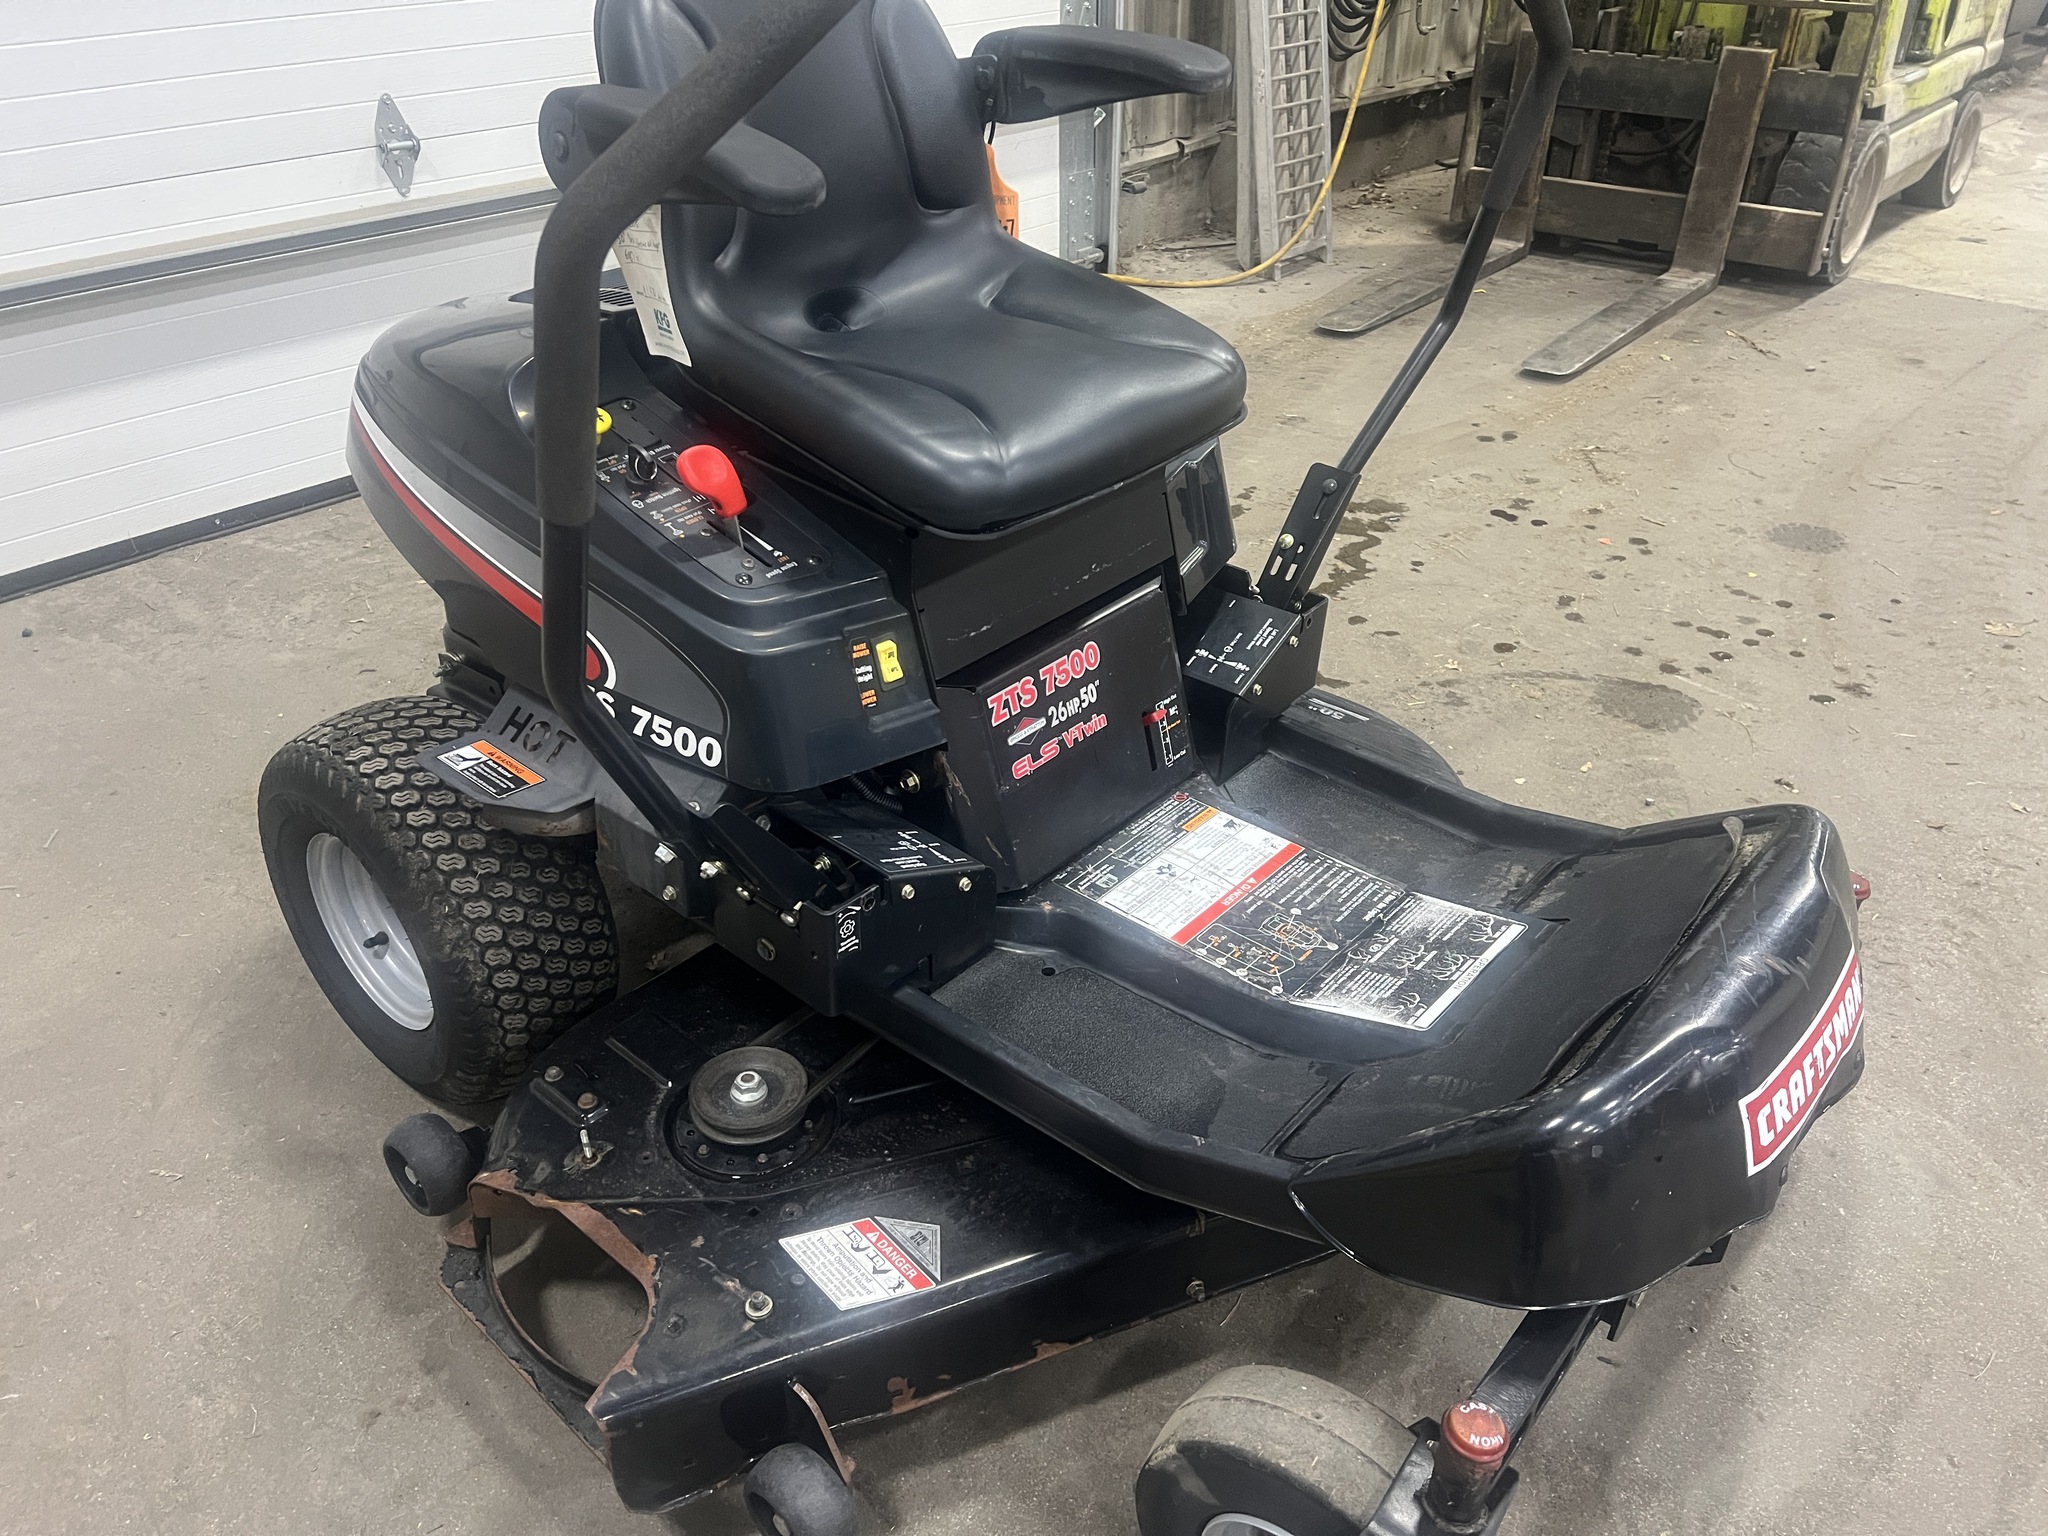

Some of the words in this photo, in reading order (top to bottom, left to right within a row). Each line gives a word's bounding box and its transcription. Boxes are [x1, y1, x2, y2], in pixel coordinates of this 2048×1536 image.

[855, 665, 873, 674] Cutting
[857, 673, 873, 683] Height
[987, 676, 1038, 728] ZTS
[1039, 640, 1101, 697] 7500
[499, 705, 578, 763] HOT
[630, 705, 723, 768] 7500
[1012, 737, 1060, 779] ELS
[1062, 712, 1107, 749] V-Twin
[495, 754, 524, 774] WARNING
[1453, 958, 1489, 990] OPERATION
[815, 1236, 836, 1256] Thrown
[832, 1256, 855, 1276] Objects
[851, 1275, 873, 1295] Hazard
[831, 1243, 863, 1272] Amputation
[879, 1240, 918, 1280] DANGER
[1460, 1402, 1496, 1414] CAST
